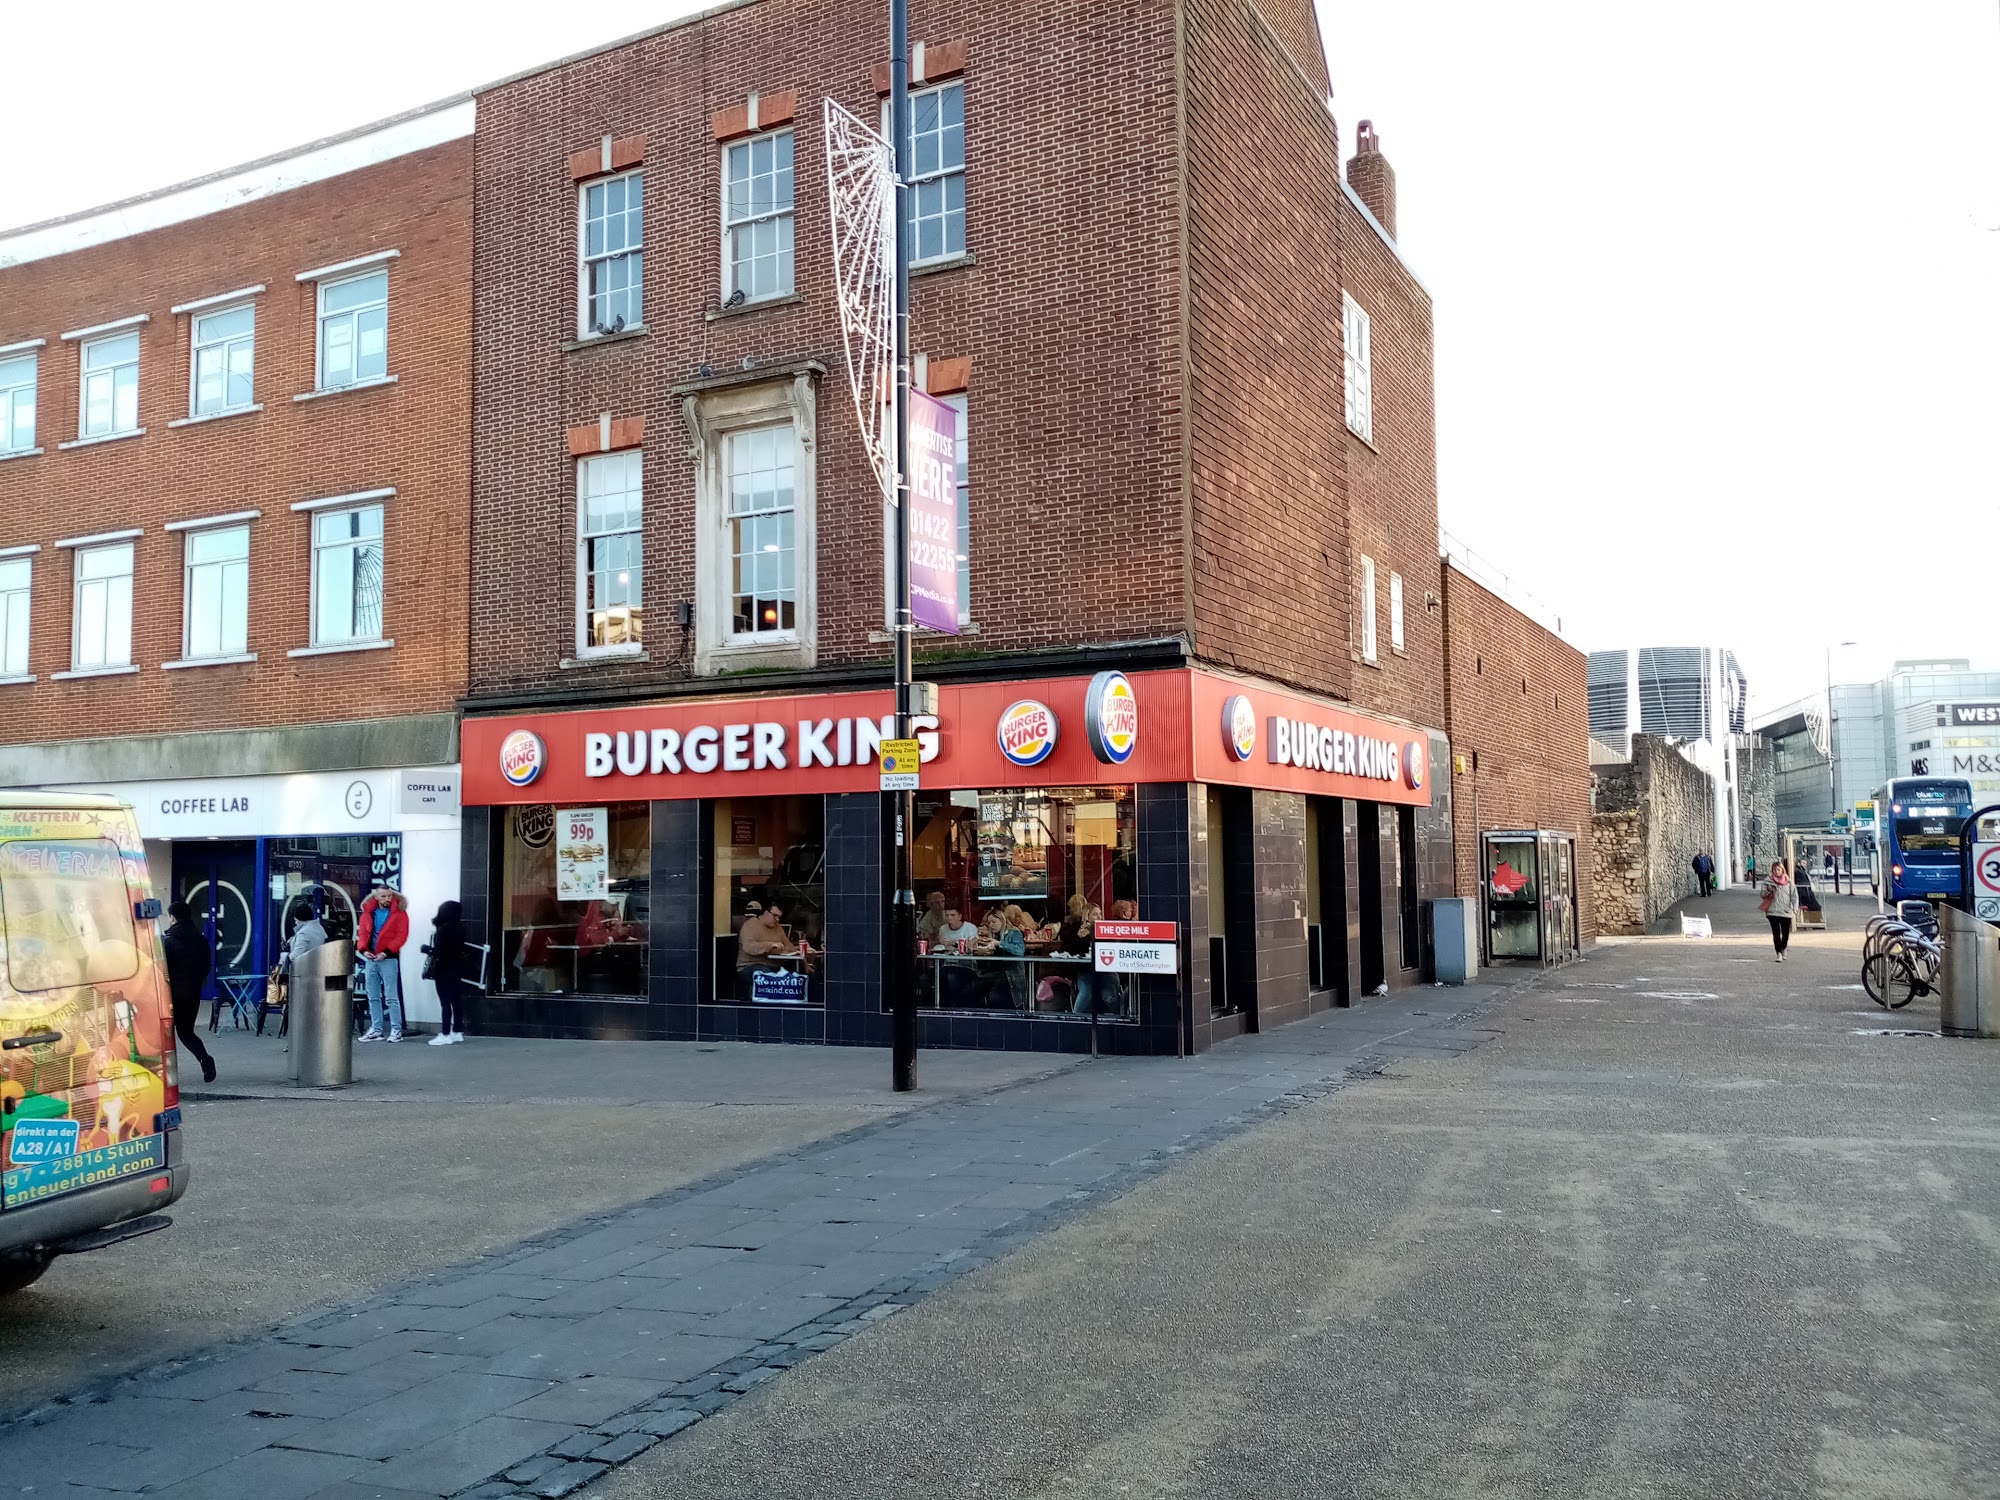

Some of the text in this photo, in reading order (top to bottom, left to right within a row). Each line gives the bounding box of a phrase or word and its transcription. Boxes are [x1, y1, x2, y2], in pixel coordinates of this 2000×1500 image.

[910, 421, 953, 458] ERTISE
[911, 508, 949, 542] 01422
[1107, 698, 1134, 713] BURGER
[1004, 711, 1046, 736] BURGER
[1105, 714, 1135, 734] KING
[585, 714, 940, 777] BURGER KING
[1006, 722, 1048, 752] KING
[504, 740, 534, 761] BURGER
[1276, 716, 1356, 776] BURGER
[1359, 735, 1398, 782] KING
[505, 750, 535, 773] KING
[1911, 757, 1929, 776] M&S
[407, 784, 436, 792] COFFEE
[161, 797, 249, 814] COFFEE LAB
[521, 805, 553, 824] BURGER
[13, 812, 80, 823] KLETTERN
[522, 813, 555, 833] KING
[570, 823, 594, 842] 99p
[1099, 926, 1149, 936] THE QE2 MILE
[1119, 949, 1160, 960] BARGATE
[1136, 961, 1171, 969] Southampton
[16, 1127, 45, 1137] direkt
[61, 1127, 76, 1137] der
[22, 1167, 32, 1182] 7
[52, 1151, 103, 1175] 28816
[107, 1138, 153, 1160] Stuhr
[6, 1156, 155, 1205] enteuerland.com
